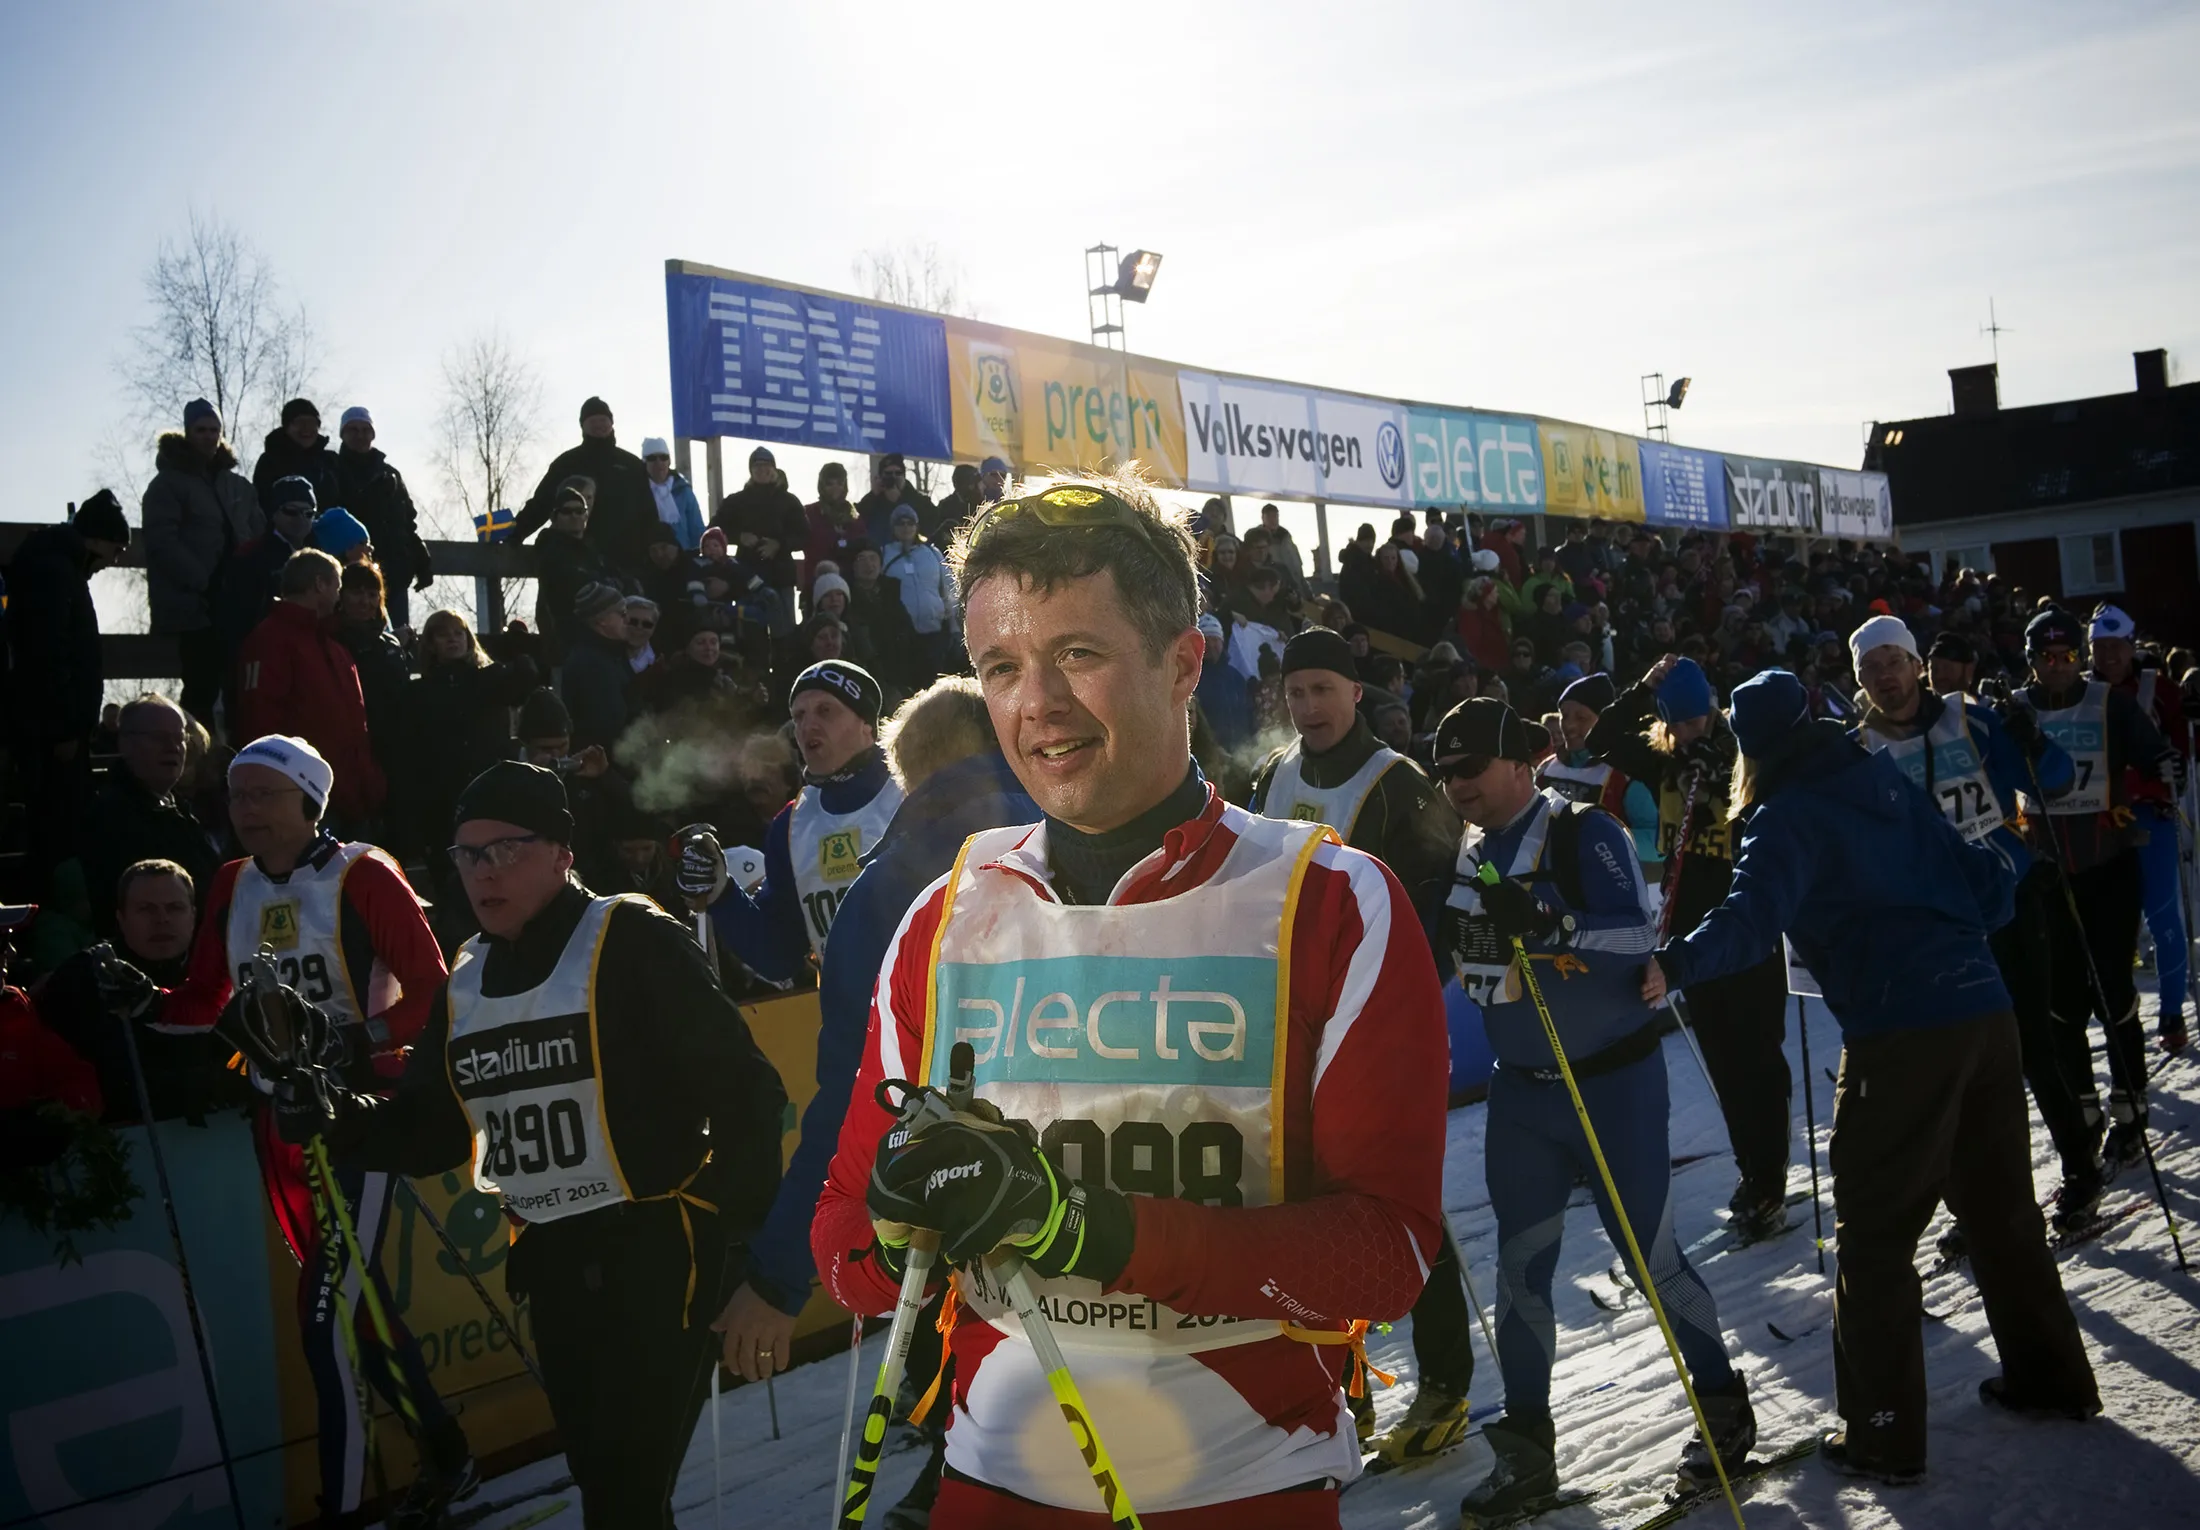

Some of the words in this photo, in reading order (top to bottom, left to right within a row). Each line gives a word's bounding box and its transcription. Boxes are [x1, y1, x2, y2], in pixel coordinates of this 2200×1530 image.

[709, 292, 886, 440] IBM
[1044, 380, 1162, 451] preem
[1189, 401, 1363, 479] Volkswagen
[1415, 417, 1537, 505] alecta
[1733, 464, 1817, 528] stadium
[1822, 484, 1877, 525] Volkswagen
[1941, 781, 1992, 824] 72
[1595, 841, 1626, 884] CRAFT
[955, 975, 1247, 1065] alecta
[455, 1037, 578, 1086] stadium
[566, 1181, 610, 1202] 2012
